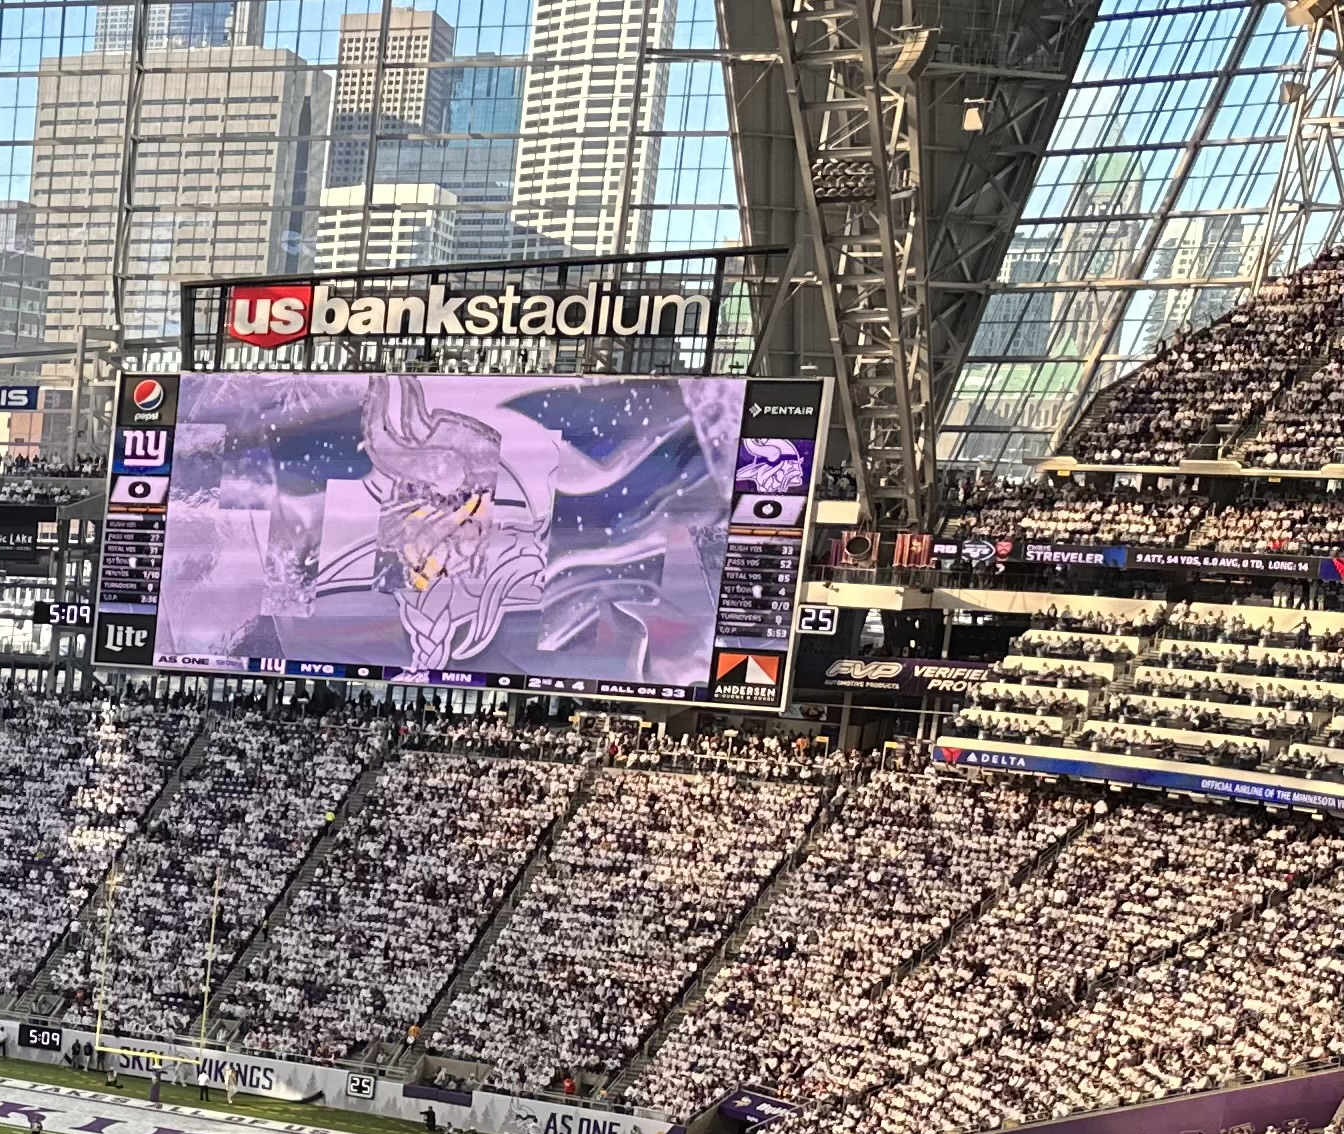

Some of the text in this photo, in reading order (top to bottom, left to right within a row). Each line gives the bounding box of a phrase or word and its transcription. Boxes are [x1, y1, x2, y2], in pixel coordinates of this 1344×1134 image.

[134, 411, 160, 422] pepsi
[763, 405, 814, 416] PENTAIR
[128, 481, 151, 499] 0
[753, 499, 783, 519] 0
[153, 522, 159, 530] 4
[781, 546, 794, 555] 33
[727, 558, 792, 568] PASS YDS 52
[1025, 551, 1105, 565] STREVELER
[1135, 553, 1309, 572] 9 ATT, 54 YDS, AVG, TD, LONG: 14
[142, 570, 160, 580] 1/10
[725, 571, 791, 583] TOTAL YDS 85
[778, 587, 786, 596] 4
[771, 601, 790, 610] 0/0
[49, 604, 91, 624] 5:09
[720, 612, 762, 622] TURNOVERS
[801, 608, 832, 631] 25
[105, 624, 148, 652] Lite
[766, 628, 788, 638] 5:53
[158, 655, 178, 664] AS
[181, 657, 210, 666] ONE
[300, 663, 370, 677] NYG 0
[441, 671, 511, 686] MIN 0
[572, 680, 585, 691] 4
[600, 684, 686, 698] BALL ON 33
[714, 685, 776, 697] ANDERSEN
[980, 754, 1027, 767] DELTA
[1201, 779, 1233, 793] OFFICIAL
[1234, 784, 1263, 797] AIRLINE
[1264, 788, 1276, 798] OF
[1277, 789, 1291, 800] THE
[1292, 792, 1336, 807] MINNESOTA
[29, 1029, 60, 1047] 5:09
[349, 1076, 372, 1094] 25
[28, 1083, 133, 1104] TAKES
[144, 1101, 214, 1120] ALL
[224, 1116, 270, 1127] OF
